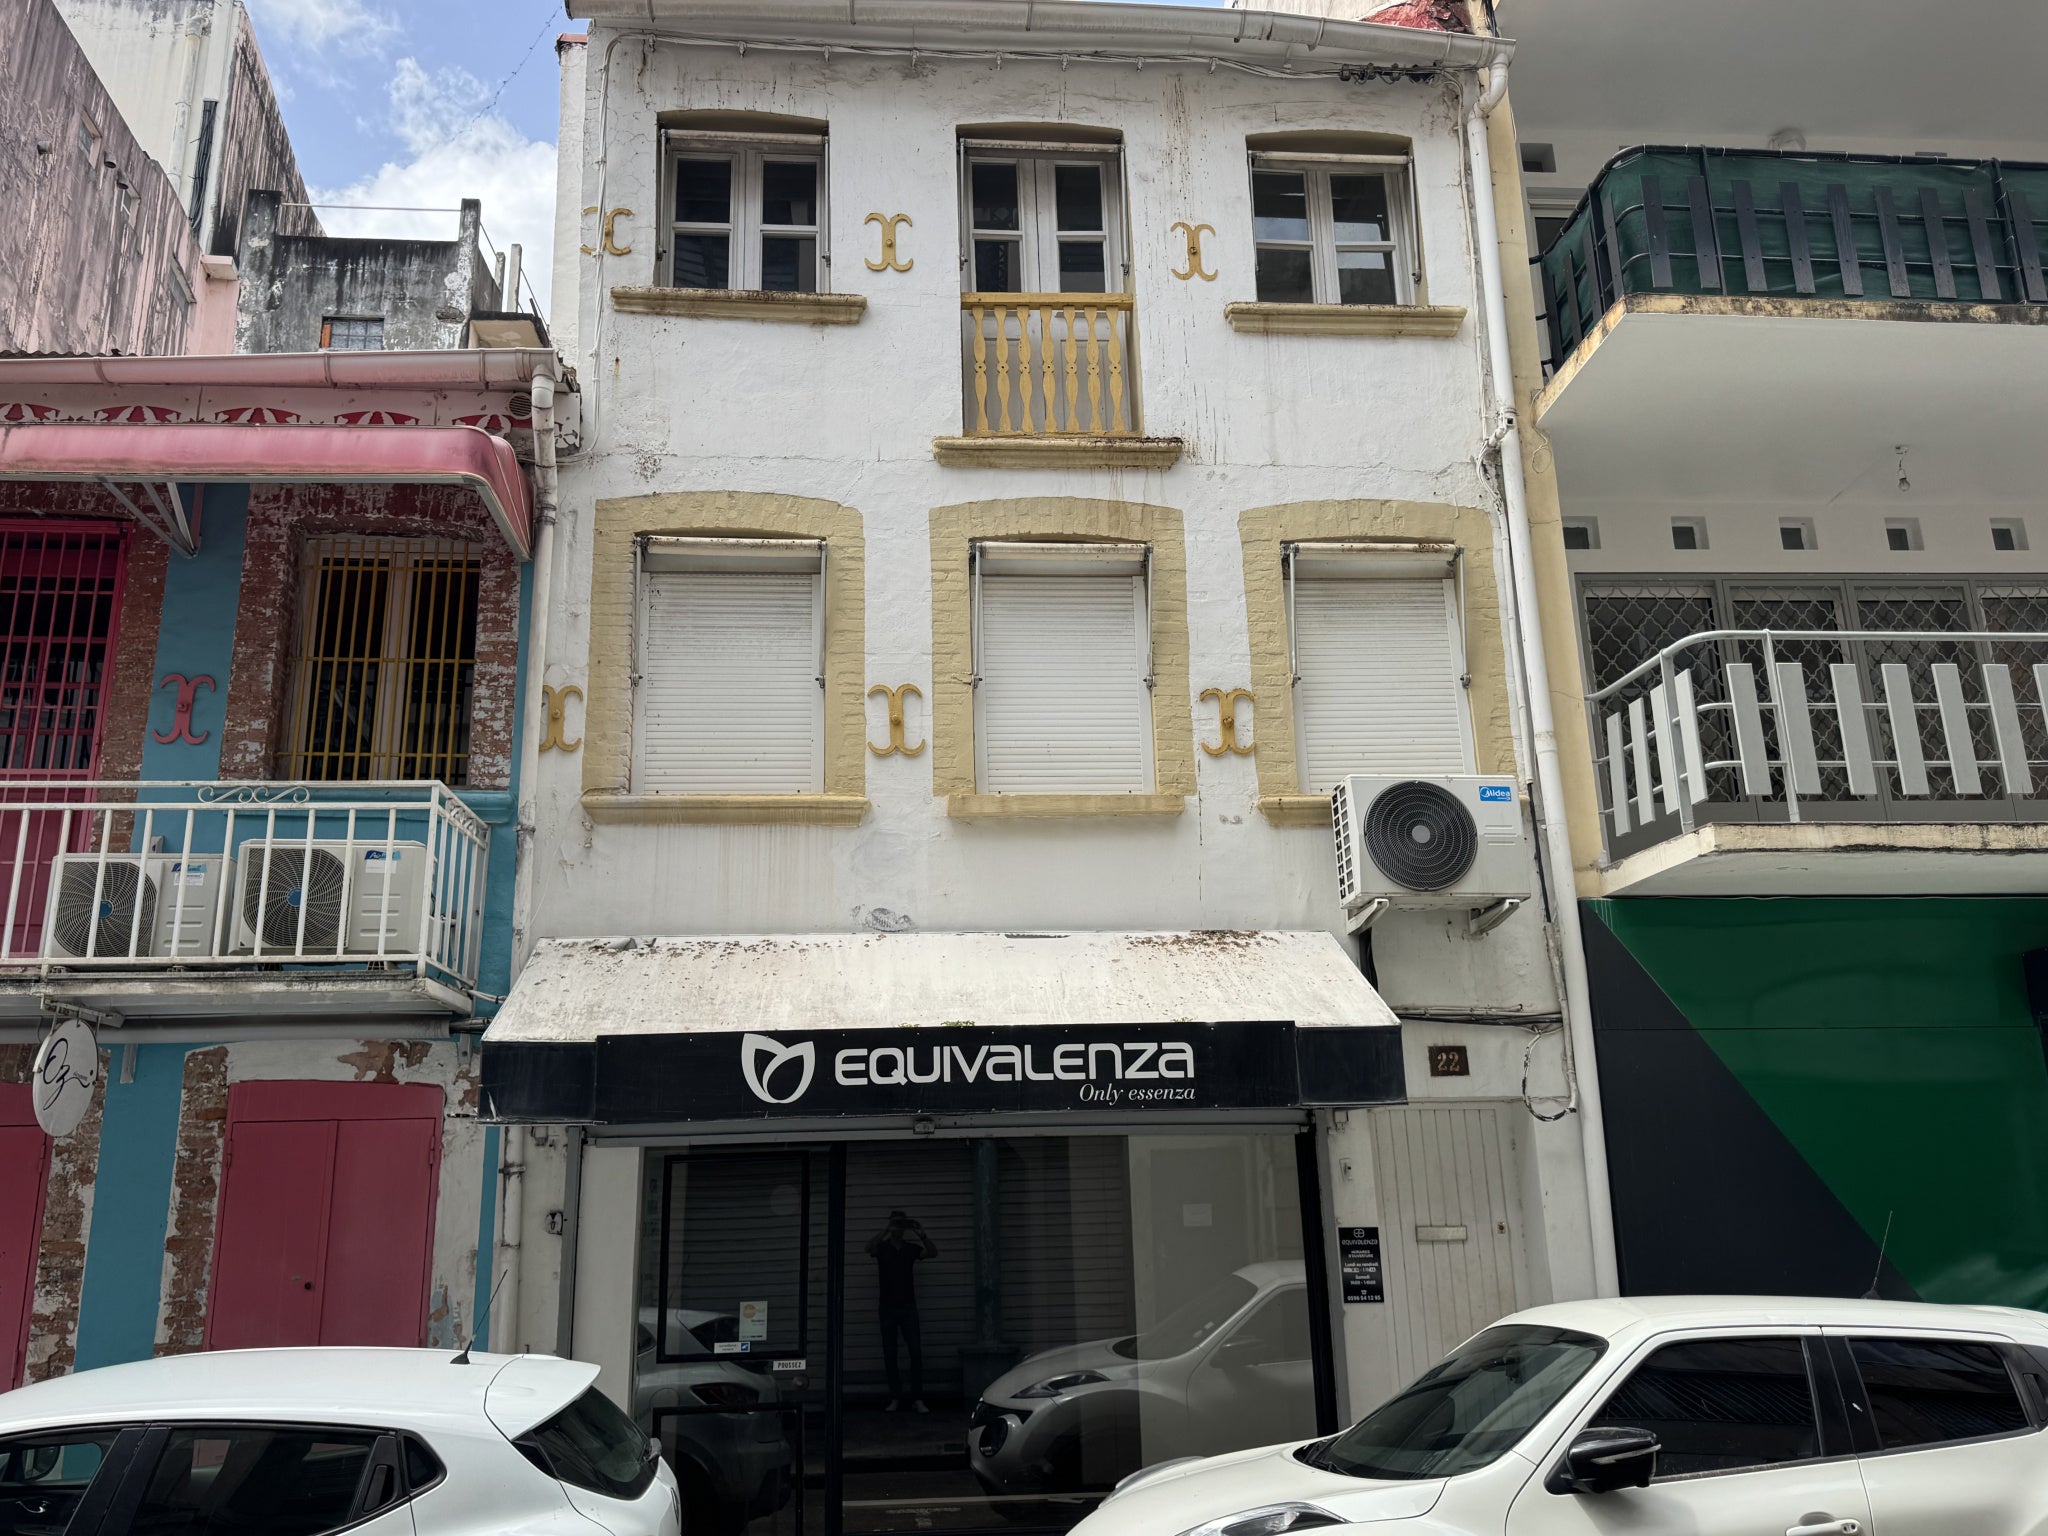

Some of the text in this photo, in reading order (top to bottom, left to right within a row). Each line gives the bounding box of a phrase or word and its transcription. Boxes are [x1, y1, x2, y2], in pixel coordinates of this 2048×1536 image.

[1481, 788, 1511, 797] Midea
[1437, 1051, 1460, 1072] 22
[1079, 1083, 1196, 1106] Only essenza
[777, 1361, 802, 1369] POUSSEZ
